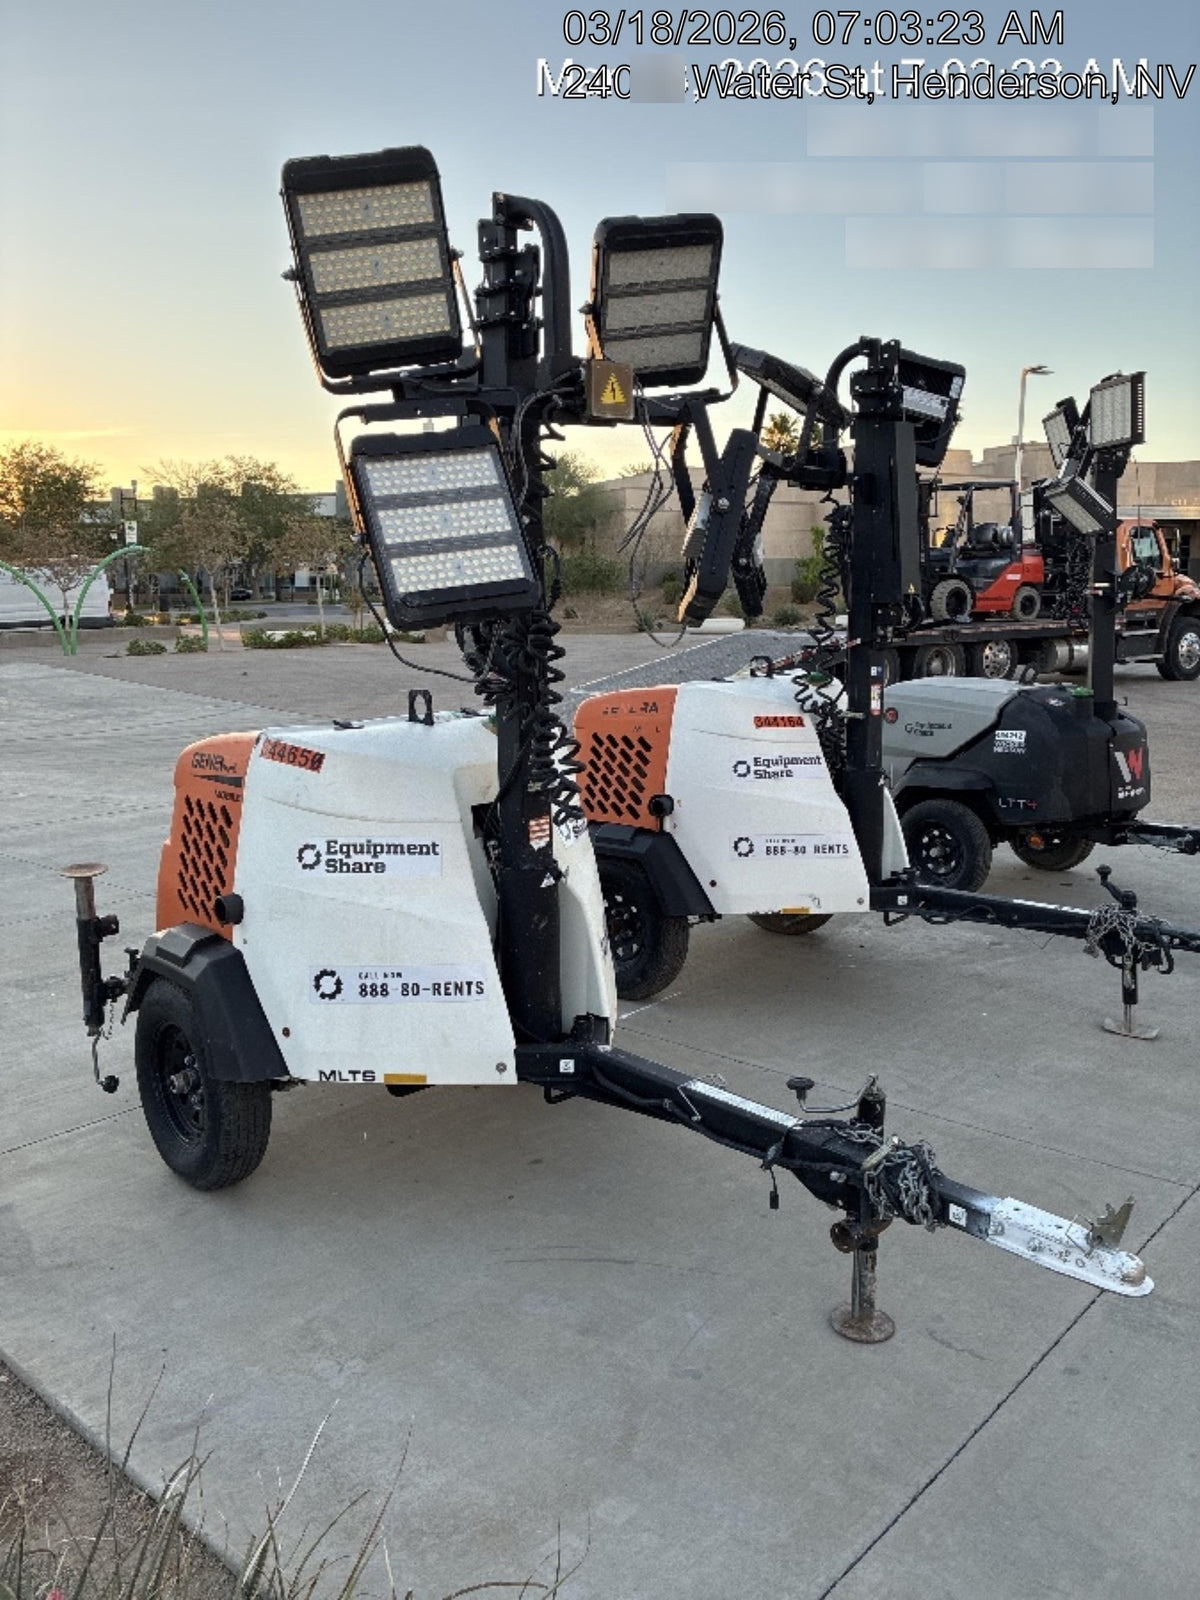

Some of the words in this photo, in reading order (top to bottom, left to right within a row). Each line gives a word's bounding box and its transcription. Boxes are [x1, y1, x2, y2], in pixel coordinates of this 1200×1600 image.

[752, 755, 822, 768] Equipment
[753, 769, 794, 779] Share
[325, 839, 440, 859] Equipment
[325, 858, 386, 874] Share
[358, 981, 485, 998] 888-80-RENTS
[318, 1069, 377, 1082] MLTS
